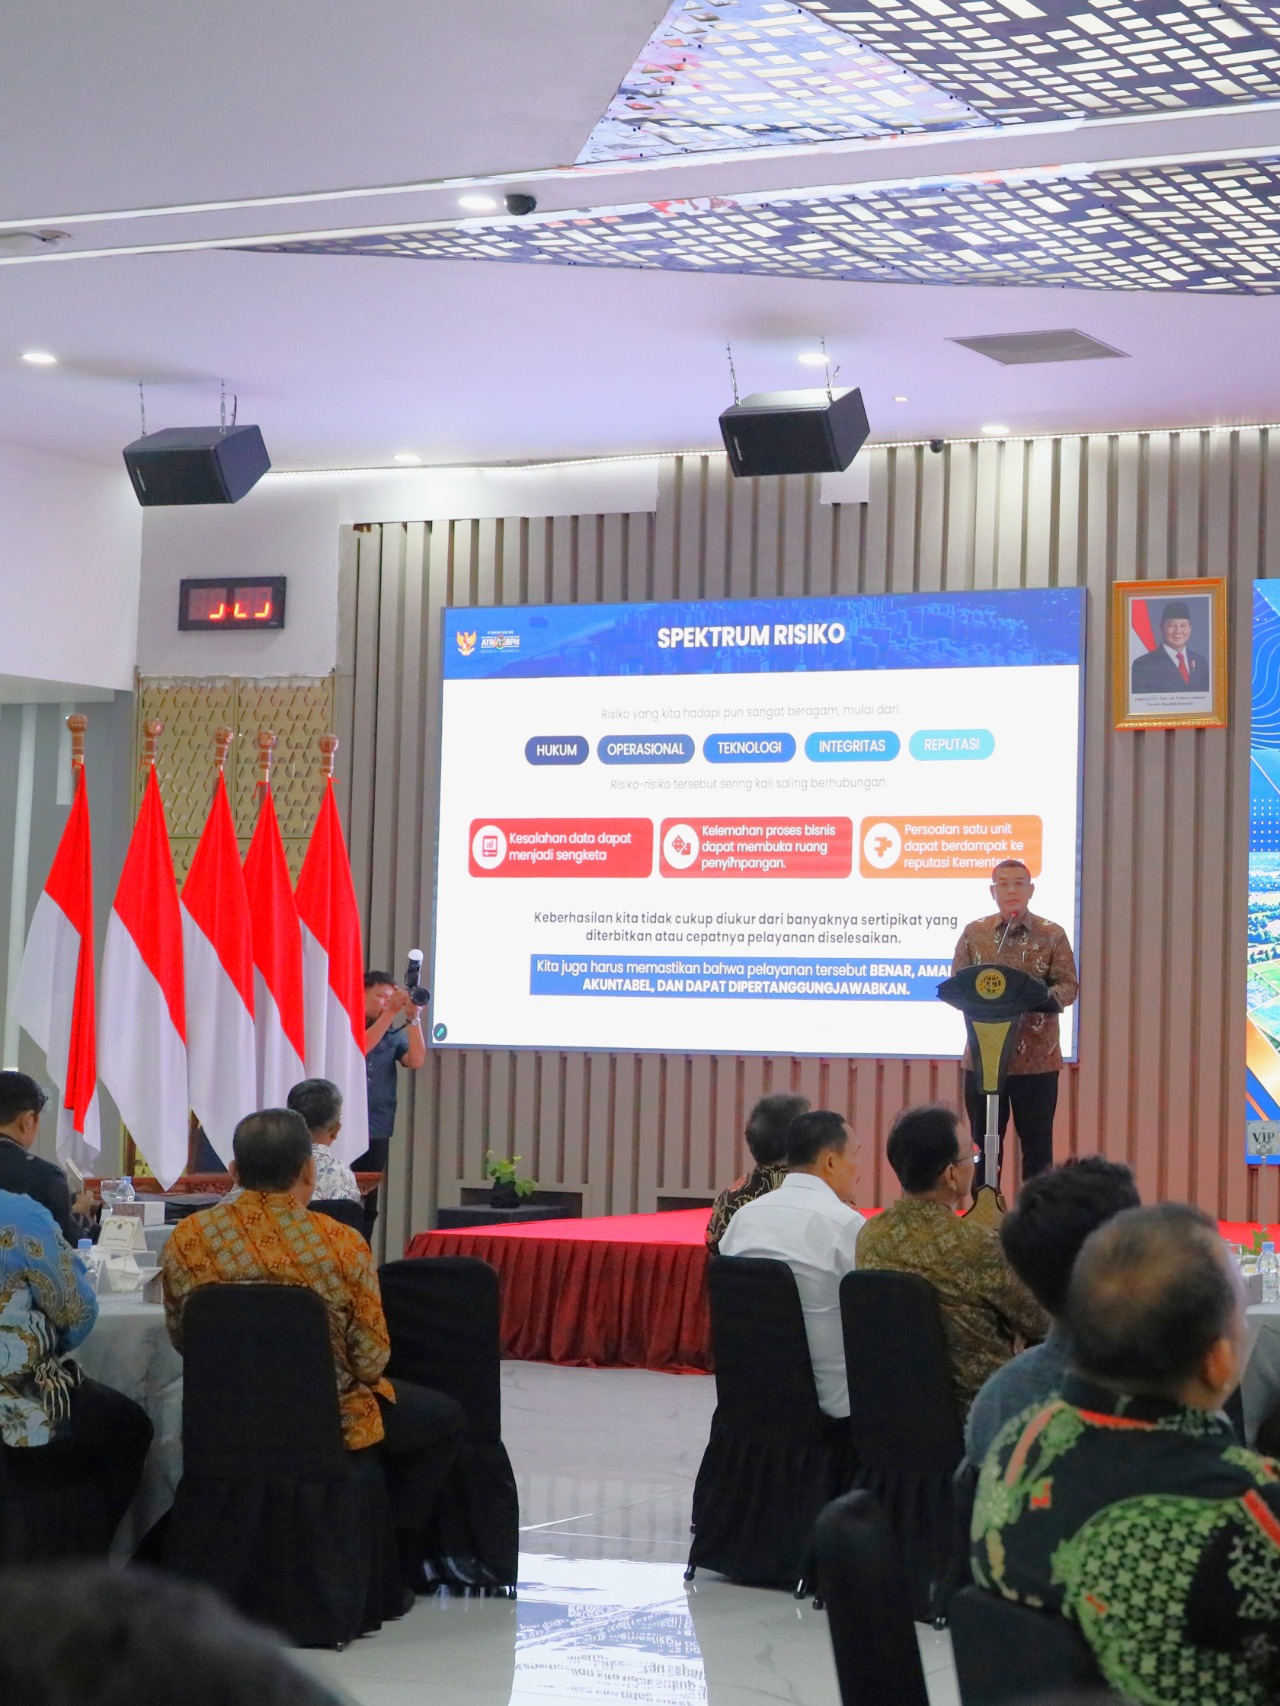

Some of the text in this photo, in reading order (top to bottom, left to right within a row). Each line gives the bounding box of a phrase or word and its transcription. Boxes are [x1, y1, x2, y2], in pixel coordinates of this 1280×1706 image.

[658, 623, 845, 648] SPEKTRUM RISIKO
[601, 704, 901, 722] Risiko yang kita hadapi pun sangat beragam, mulai dari:
[537, 744, 577, 756] HUKUM
[607, 742, 684, 755] OPERASIONAL
[717, 741, 782, 754] TEKNOLOGI
[819, 739, 885, 752] INTEGRITAS
[924, 737, 980, 750] REPUTASI
[610, 777, 888, 792] Risiko-risiko tersebut sering kali saling berhubungan.
[702, 824, 835, 839] Kelemahan proses bisnis
[904, 823, 1012, 835] Persoalan satu unit
[509, 832, 632, 847] Kesalahan data dapat
[904, 839, 1024, 854] dapat berdampak ke
[701, 840, 827, 855] dapat membuka ruang
[509, 848, 607, 864] menjadi sengketa
[904, 856, 950, 871] reputasi
[701, 858, 785, 871] penyimpangan.
[535, 911, 957, 929] Keberhasilan kita tidak cukup diukur dari banyaknya sertipikat yang
[586, 928, 901, 946] diterbitkan atau cepatnya pelayanan diselesaikan.
[537, 959, 559, 972] Kita
[561, 960, 587, 976] juga
[590, 960, 623, 973] harus
[627, 961, 701, 974] memastikan
[703, 962, 744, 975] bahwa
[747, 963, 813, 979] pelayanan
[815, 963, 867, 976] tersebut
[870, 964, 915, 978] BENAR,
[583, 978, 910, 995] AKUNTABEL, DAN DAPAT DIPERTANGGUNGJAWABKAN.
[1252, 1132, 1275, 1143] VIP
